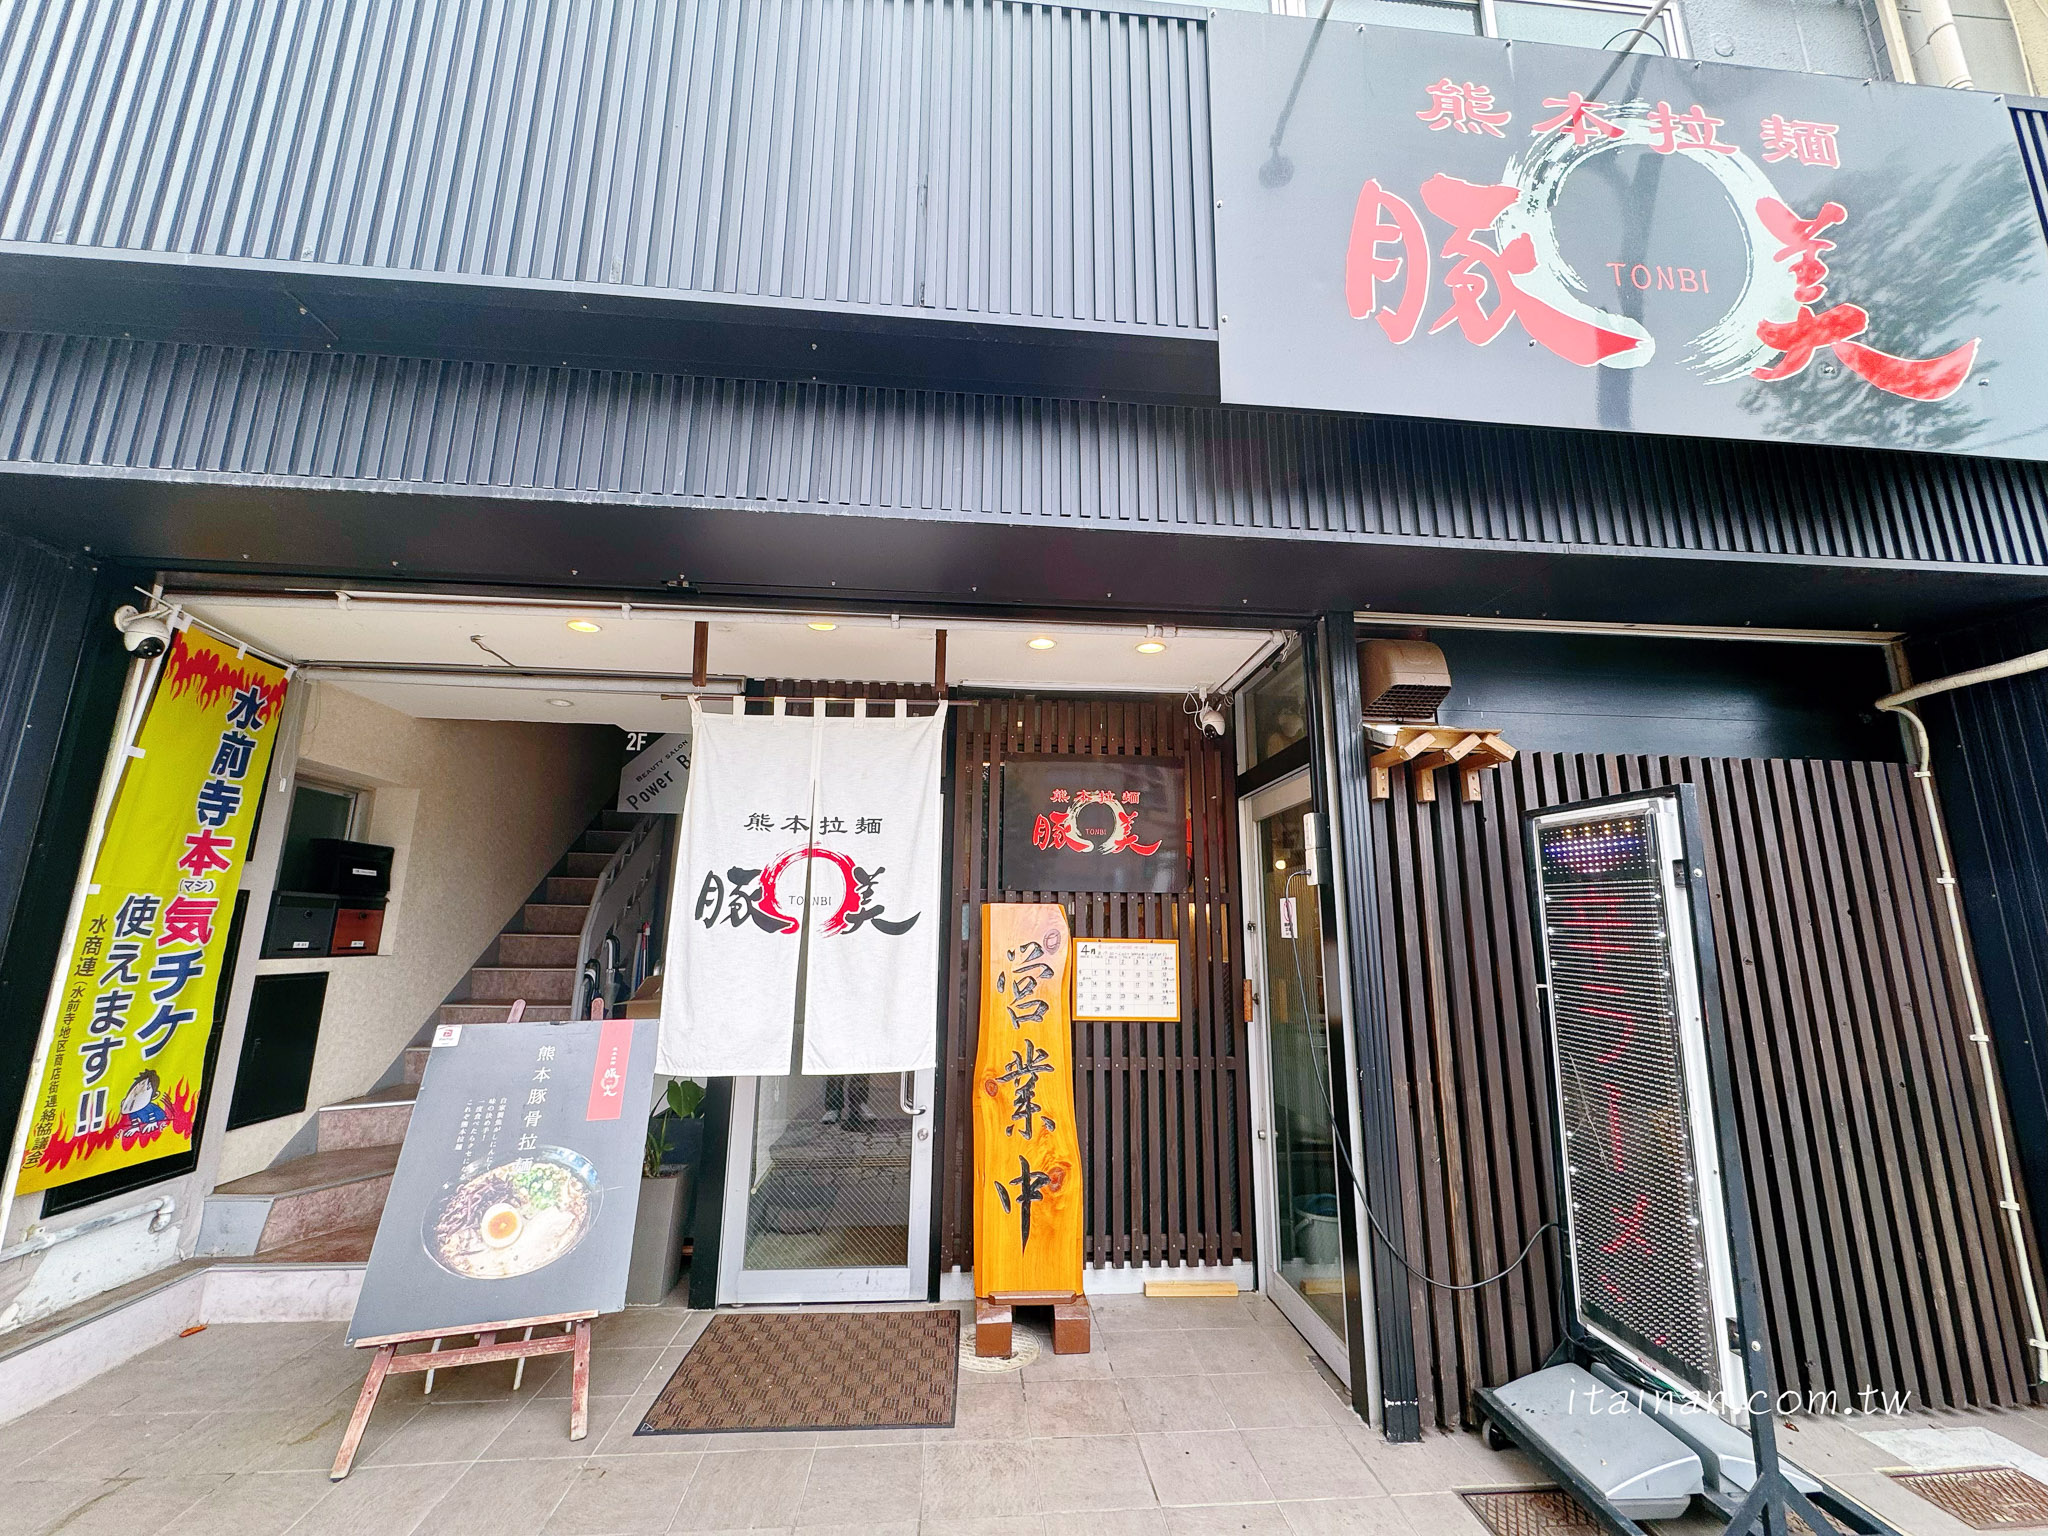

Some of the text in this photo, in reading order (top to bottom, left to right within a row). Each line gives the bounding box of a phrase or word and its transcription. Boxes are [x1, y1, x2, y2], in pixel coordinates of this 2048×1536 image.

[1605, 262, 1710, 295] TONBI
[625, 732, 648, 751] 2F
[635, 739, 689, 782] BEAUTY SALON
[626, 751, 692, 811] Power B
[1085, 828, 1107, 836] TONBI
[994, 941, 1055, 1257] 営業中
